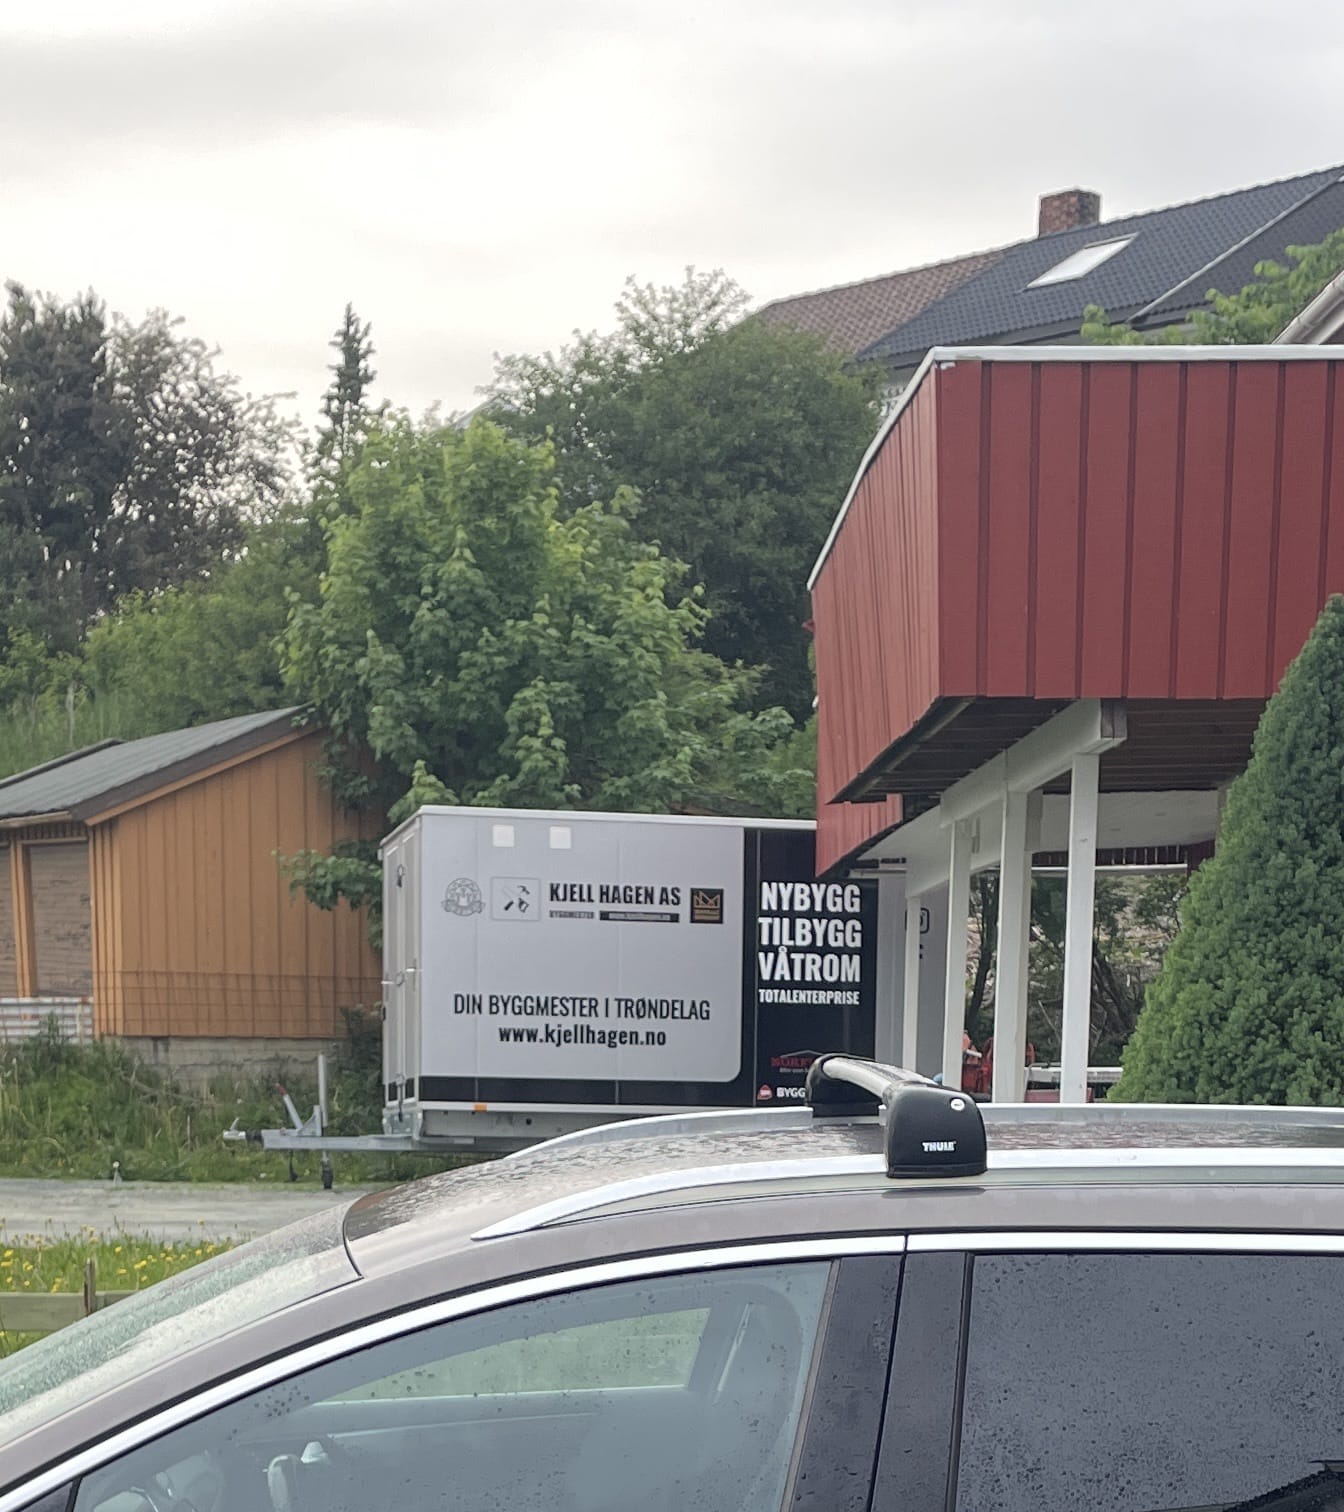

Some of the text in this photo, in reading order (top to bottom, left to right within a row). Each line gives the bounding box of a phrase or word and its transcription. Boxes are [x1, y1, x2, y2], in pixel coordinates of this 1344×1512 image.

[549, 882, 681, 906] KJELL HAGEN AS
[761, 881, 860, 913] NYBYGG
[758, 917, 862, 948] TILBYGG
[758, 945, 860, 982] VÅTROM
[454, 993, 711, 1021] DIN BYGGMESTER I TRØNDELAG
[758, 989, 860, 1005] TOTALENTERPRISE
[498, 1023, 667, 1048] www.kjellhagen.no
[922, 1141, 955, 1152] THULE
